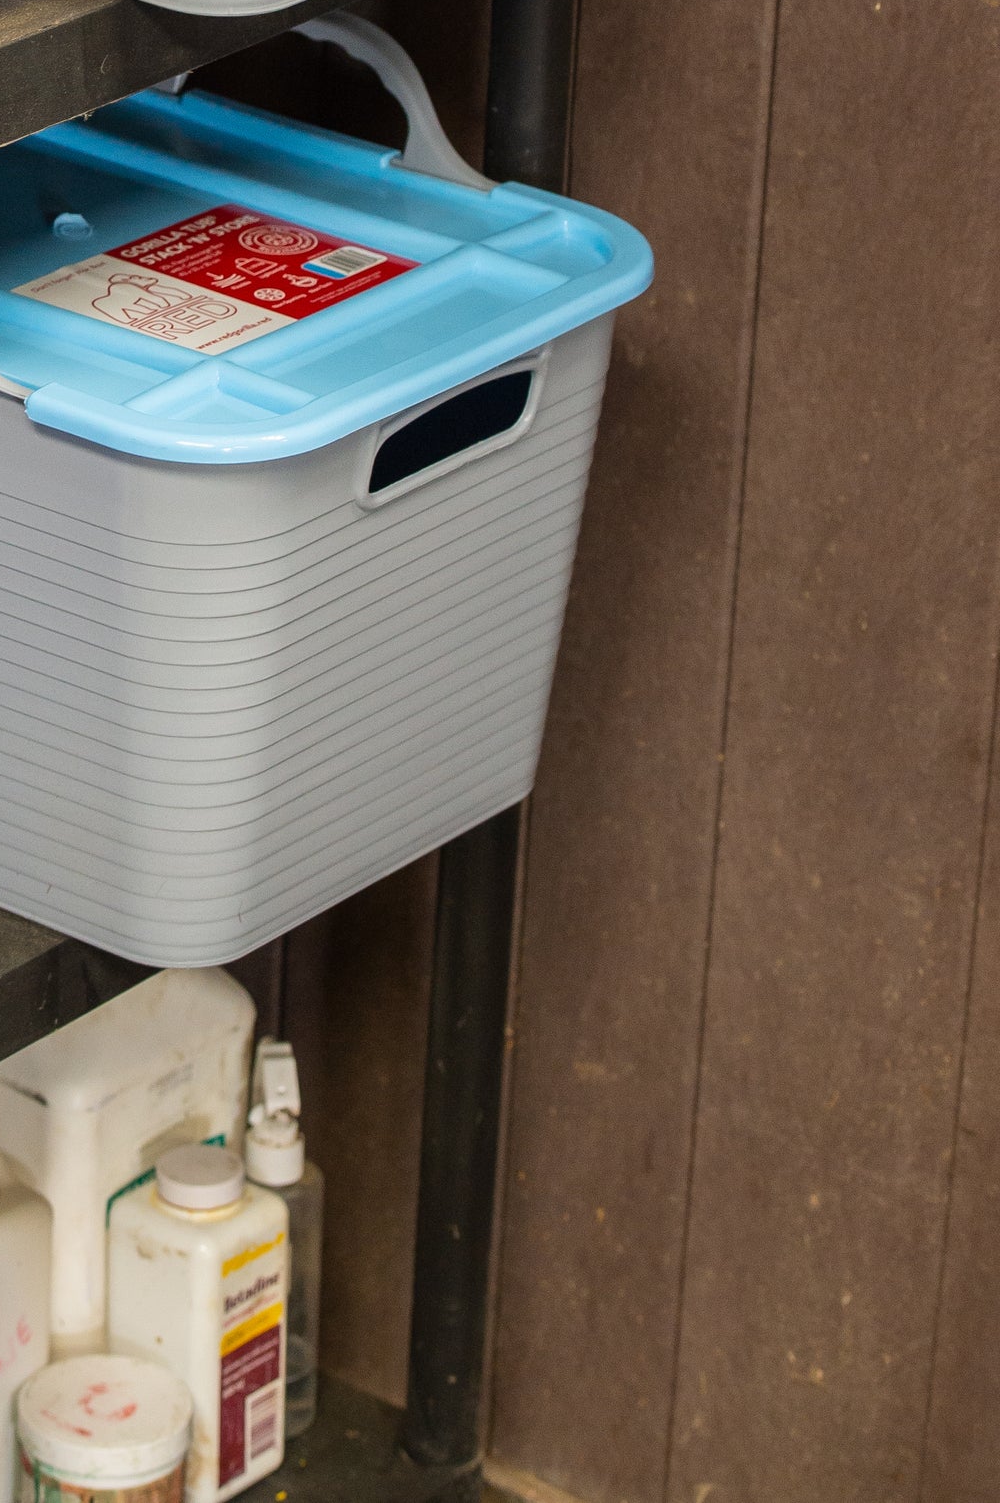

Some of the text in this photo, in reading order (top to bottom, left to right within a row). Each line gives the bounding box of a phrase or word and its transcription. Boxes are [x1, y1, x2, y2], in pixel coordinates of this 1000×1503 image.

[120, 230, 188, 258] GORILLA
[139, 242, 194, 265] STACK
[208, 214, 261, 237] STORE
[139, 300, 238, 341] RED
